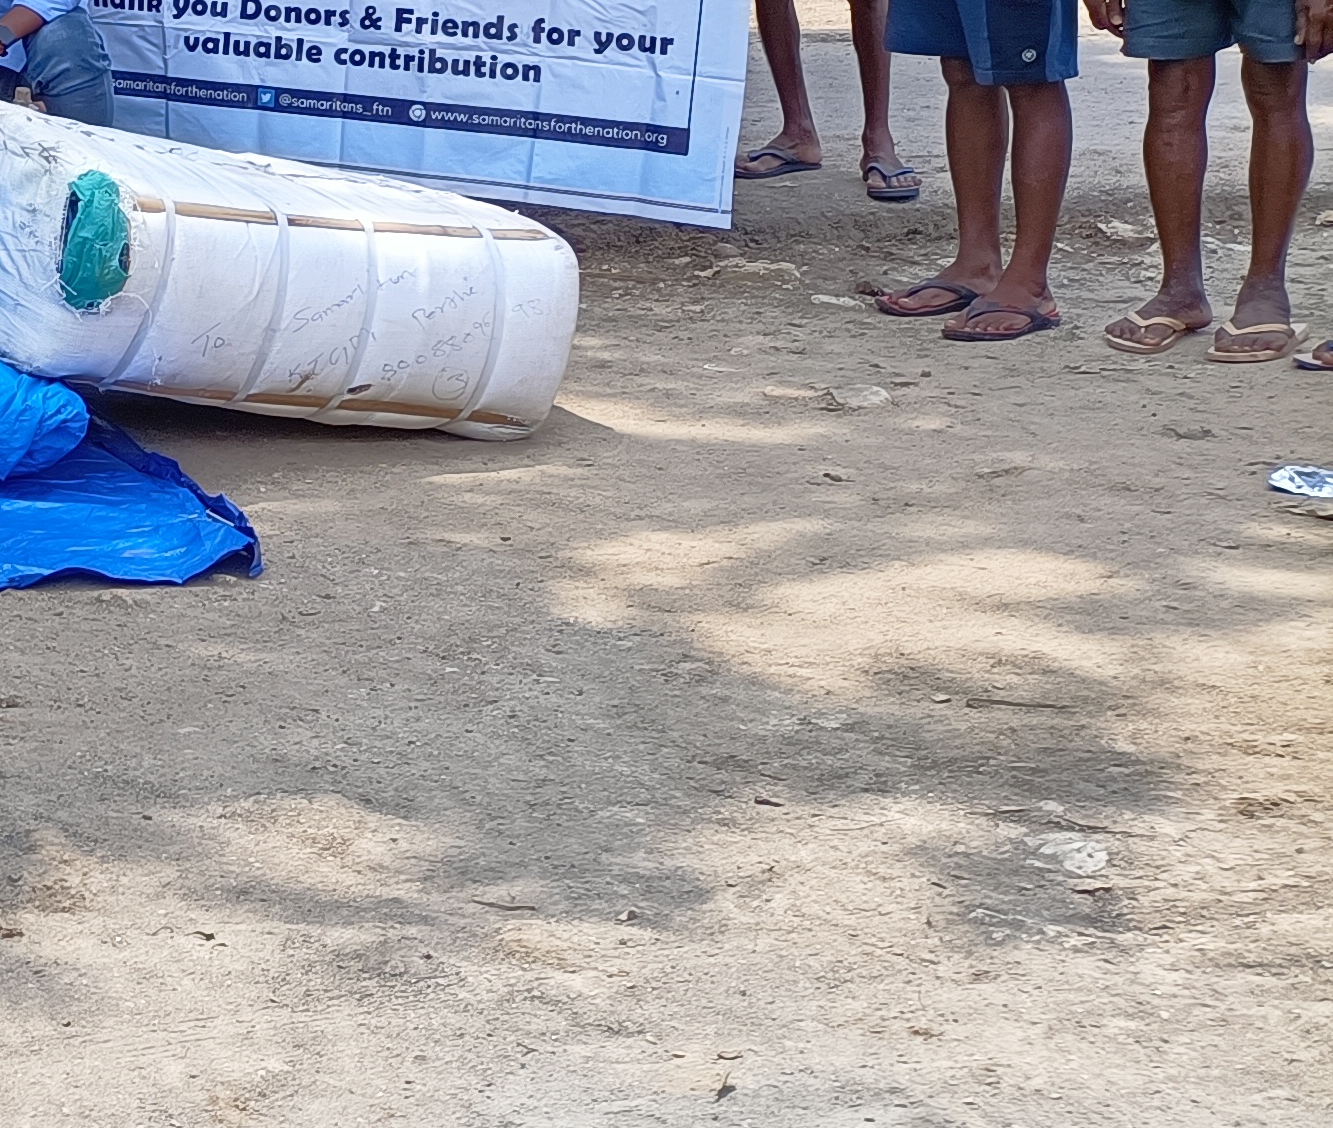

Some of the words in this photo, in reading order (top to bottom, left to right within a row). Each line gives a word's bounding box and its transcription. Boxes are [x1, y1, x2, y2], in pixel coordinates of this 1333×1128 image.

[183, 31, 323, 66] valuable
[333, 43, 543, 84] contribution
[359, 6, 383, 30] &
[395, 6, 519, 44] Friends
[531, 17, 581, 46] for
[593, 29, 675, 58] your
[279, 93, 393, 117] @samaritans_ftn
[430, 108, 669, 147] www.samaritansforthenation.org
